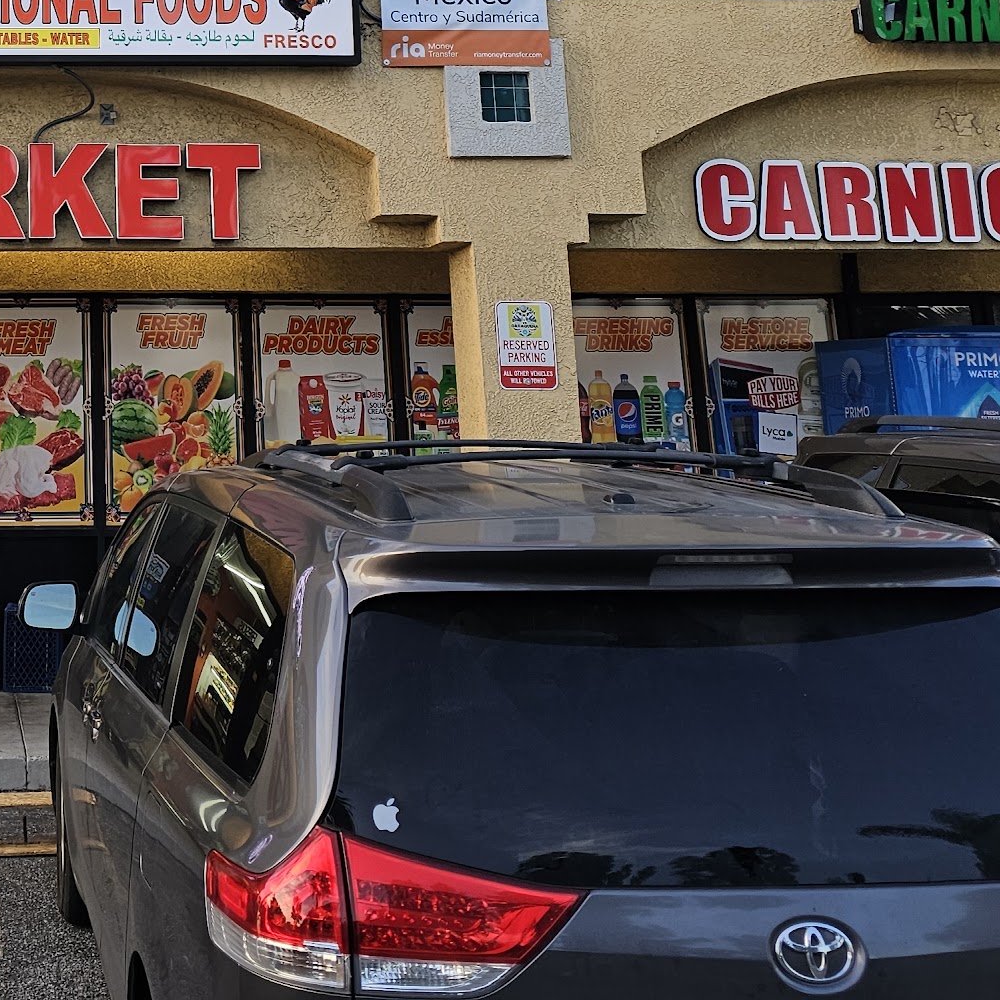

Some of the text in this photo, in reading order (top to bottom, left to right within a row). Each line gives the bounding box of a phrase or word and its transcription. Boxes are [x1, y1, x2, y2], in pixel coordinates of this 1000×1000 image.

[390, 9, 541, 26] Centro y Sudamérica
[50, 32, 91, 46] WATER
[225, 30, 255, 48] لحوم
[263, 34, 337, 49] FRESCO
[390, 35, 426, 58] ria
[428, 42, 454, 51] Money
[428, 50, 459, 58] Transfer
[473, 51, 543, 60] riamoneytransfer.com
[137, 313, 206, 332] FRESH
[288, 315, 355, 335] DAIRY
[573, 317, 674, 335] EFRESHING
[721, 317, 810, 335] IN-STORE
[140, 330, 203, 349] FRUIT
[263, 334, 380, 355] PRODUCTS
[503, 340, 550, 351] RESERVED
[586, 334, 653, 352] DRINKS
[721, 334, 814, 352] SERVICES
[508, 352, 547, 363] PARKING
[954, 351, 1000, 367] PRIM
[968, 369, 999, 378] WATER
[750, 379, 768, 394] PAY
[770, 377, 797, 392] YOUR
[365, 389, 386, 401] Daisy
[752, 392, 799, 409] BILLS HERE
[643, 394, 664, 433] PRIME
[671, 412, 685, 426] G
[844, 405, 871, 418] PRIMO
[620, 422, 638, 430] pepsi
[762, 425, 787, 438] Lyca
